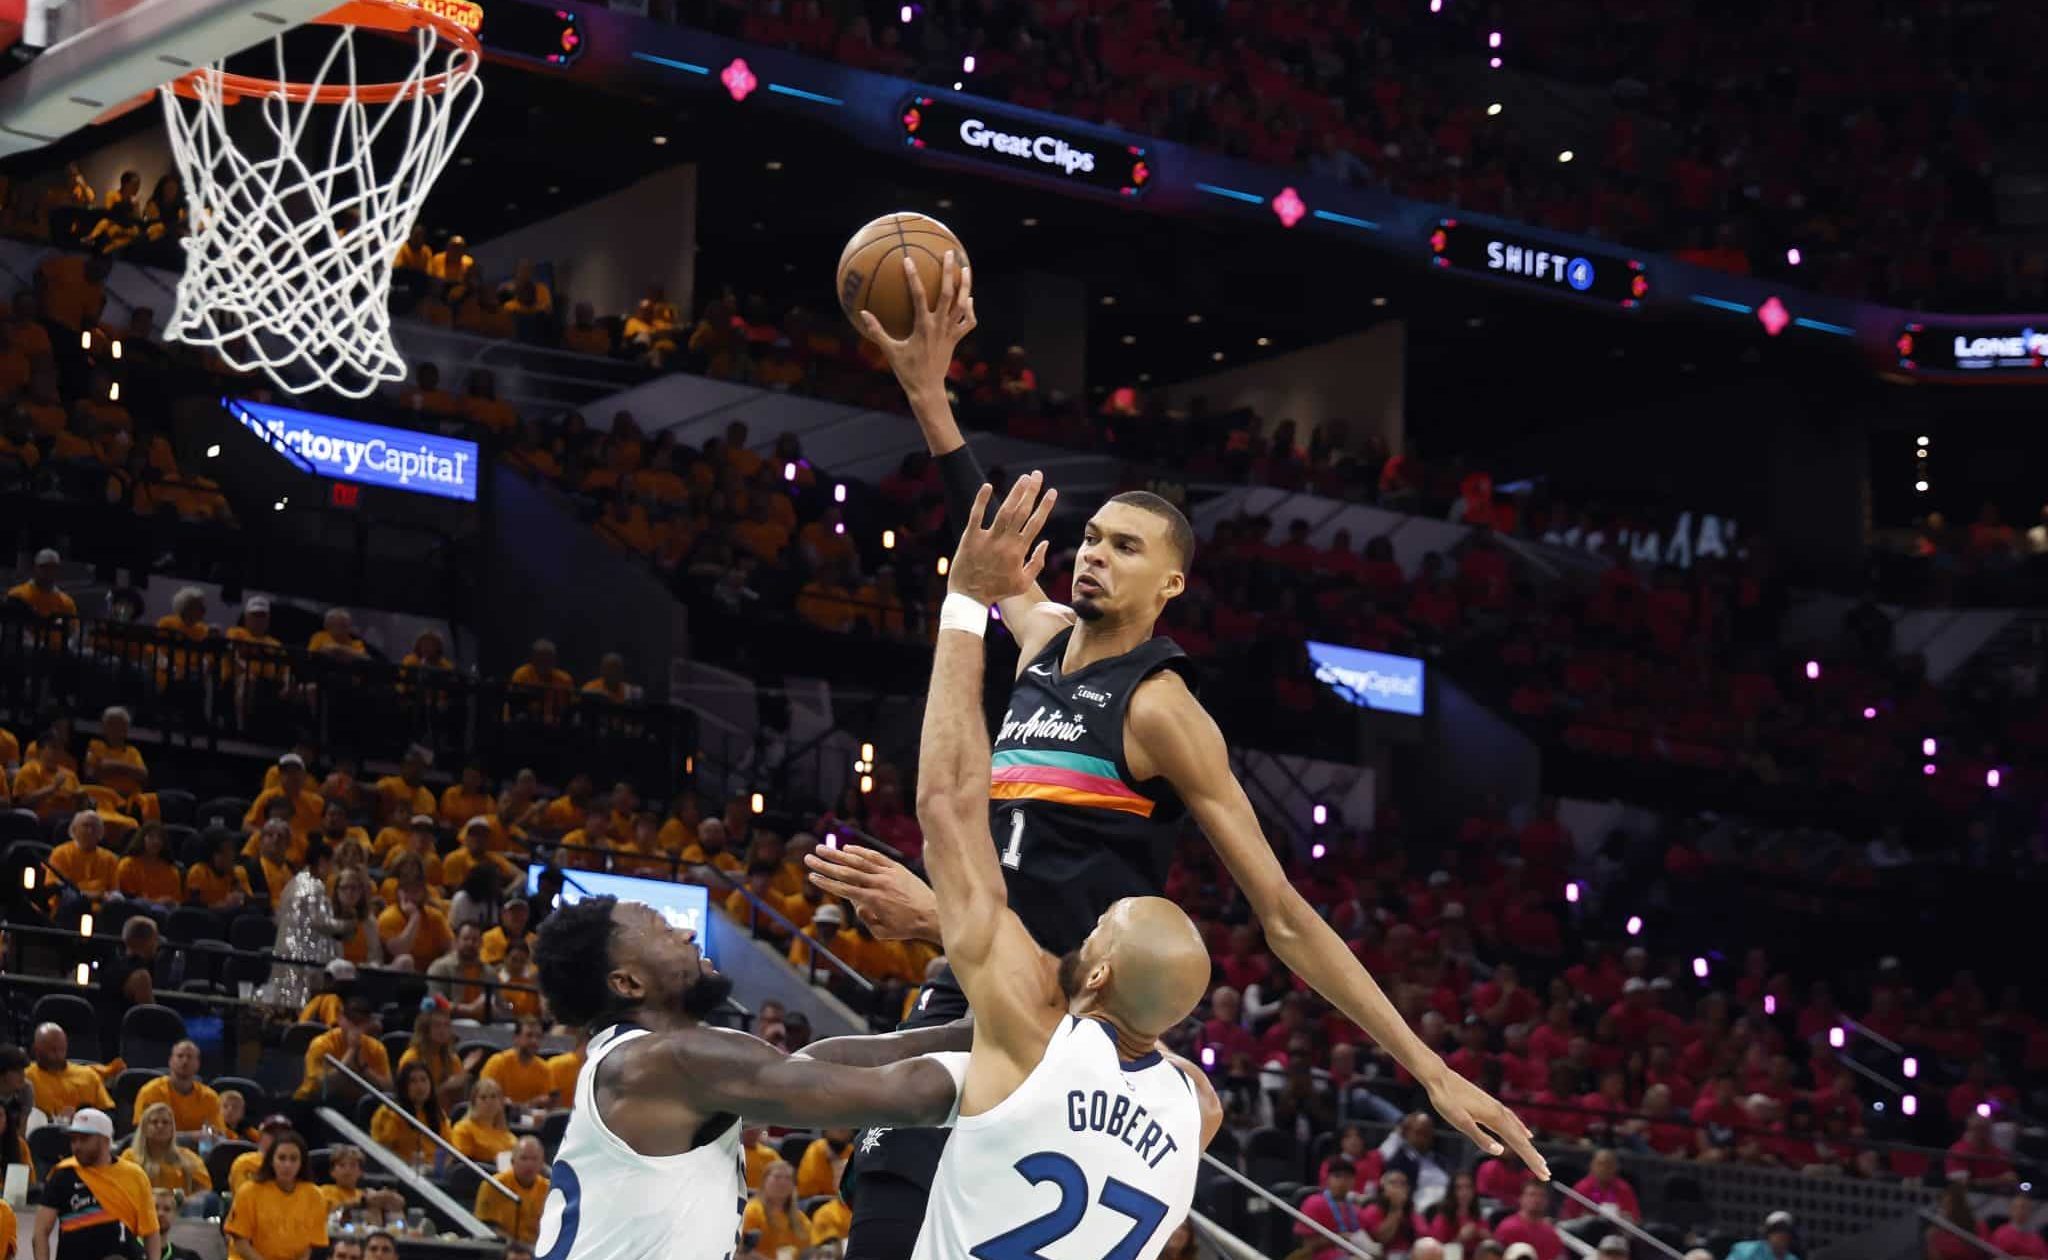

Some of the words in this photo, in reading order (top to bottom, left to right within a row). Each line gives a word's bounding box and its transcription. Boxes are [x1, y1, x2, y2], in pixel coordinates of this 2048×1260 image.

[960, 119, 1033, 158] Great
[1033, 136, 1095, 174] Clips
[1014, 706, 1087, 744] Antonio
[1001, 808, 1025, 871] 1
[1067, 1089, 1178, 1169] GOBERT
[969, 1151, 1170, 1260] 27
